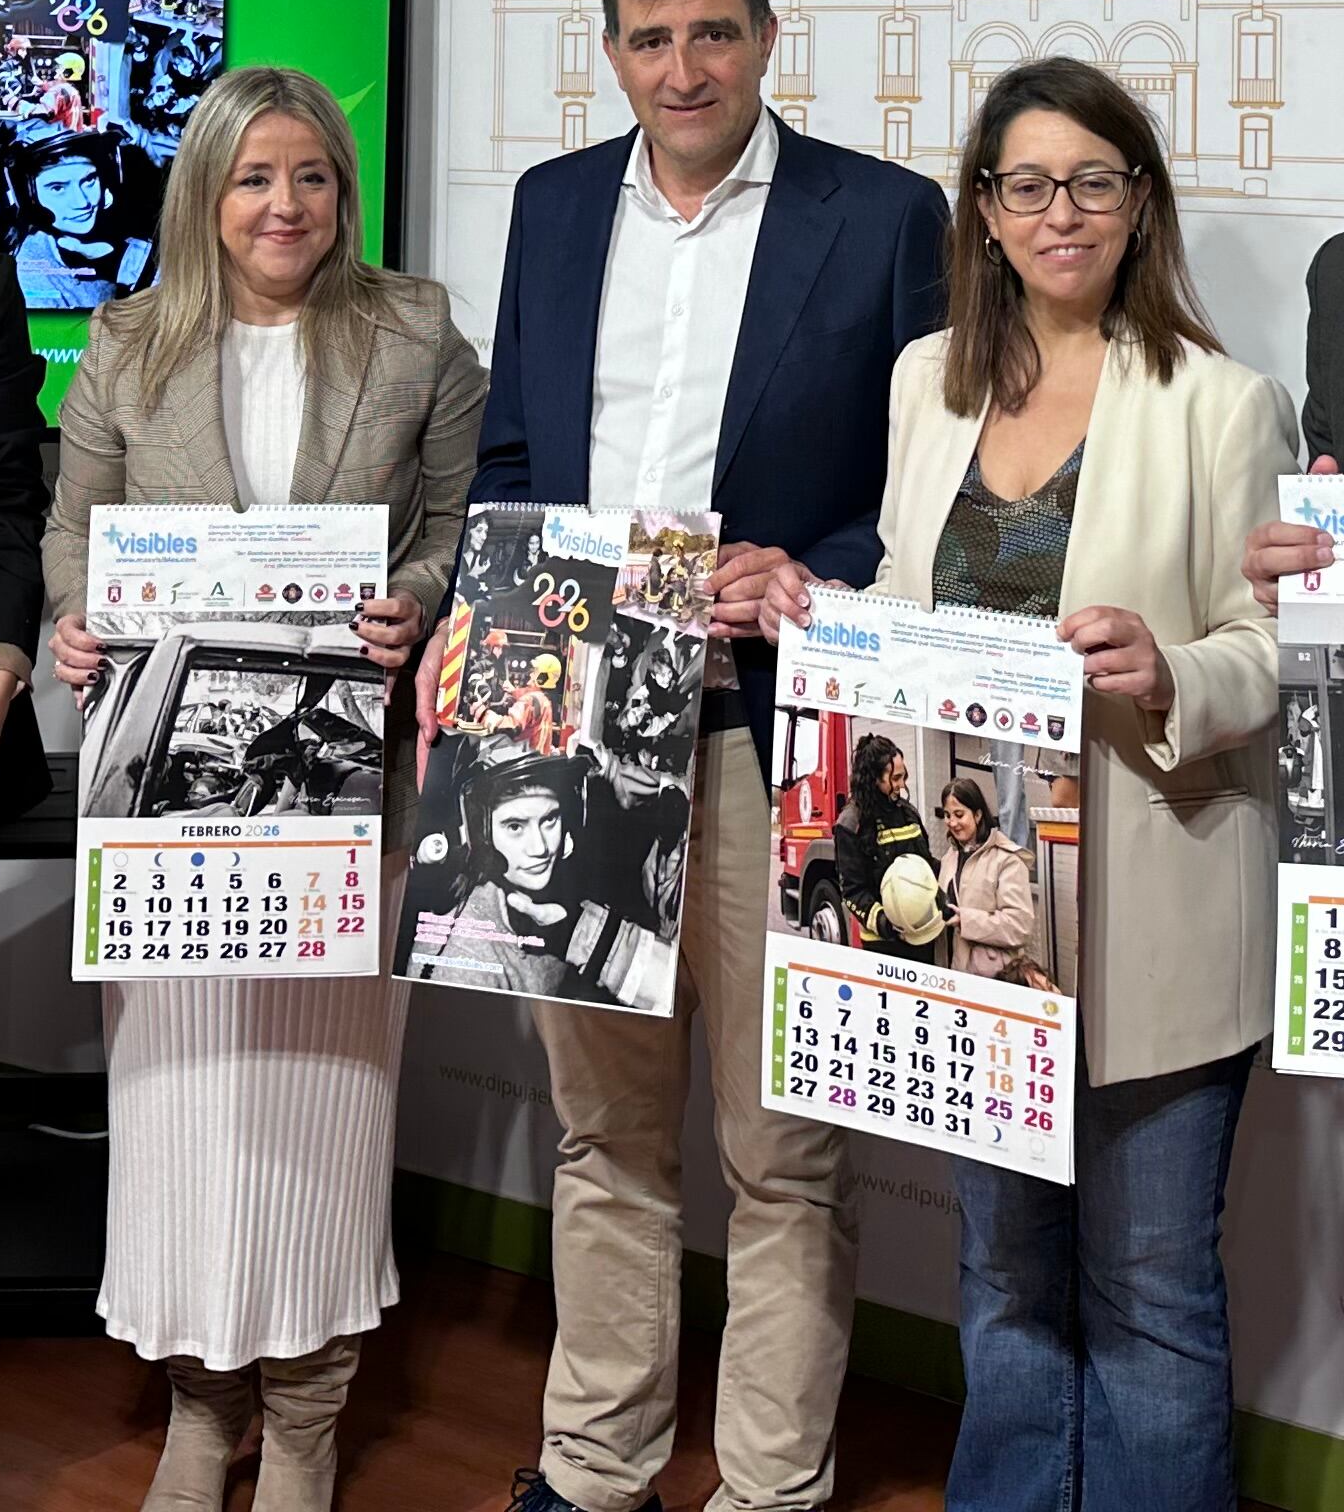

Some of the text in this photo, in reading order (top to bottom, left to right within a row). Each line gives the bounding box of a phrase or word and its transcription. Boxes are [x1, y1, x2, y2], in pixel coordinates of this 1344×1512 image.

[532, 573, 589, 632] 2026
[181, 825, 280, 837] FEBRERO 2026
[113, 871, 359, 891] 2 3 4 5 6 7 8
[112, 893, 365, 914] 9 10 11 12 13 14 15
[1325, 907, 1338, 929] 1
[1323, 938, 1342, 959] 8
[877, 963, 955, 992] JULIO 2026
[791, 1024, 1054, 1104] 13 14 15 16 17 18 19
[790, 1050, 1053, 1131] 20 21 22 23 24 25 26
[852, 1172, 962, 1215] ww.dipuja
